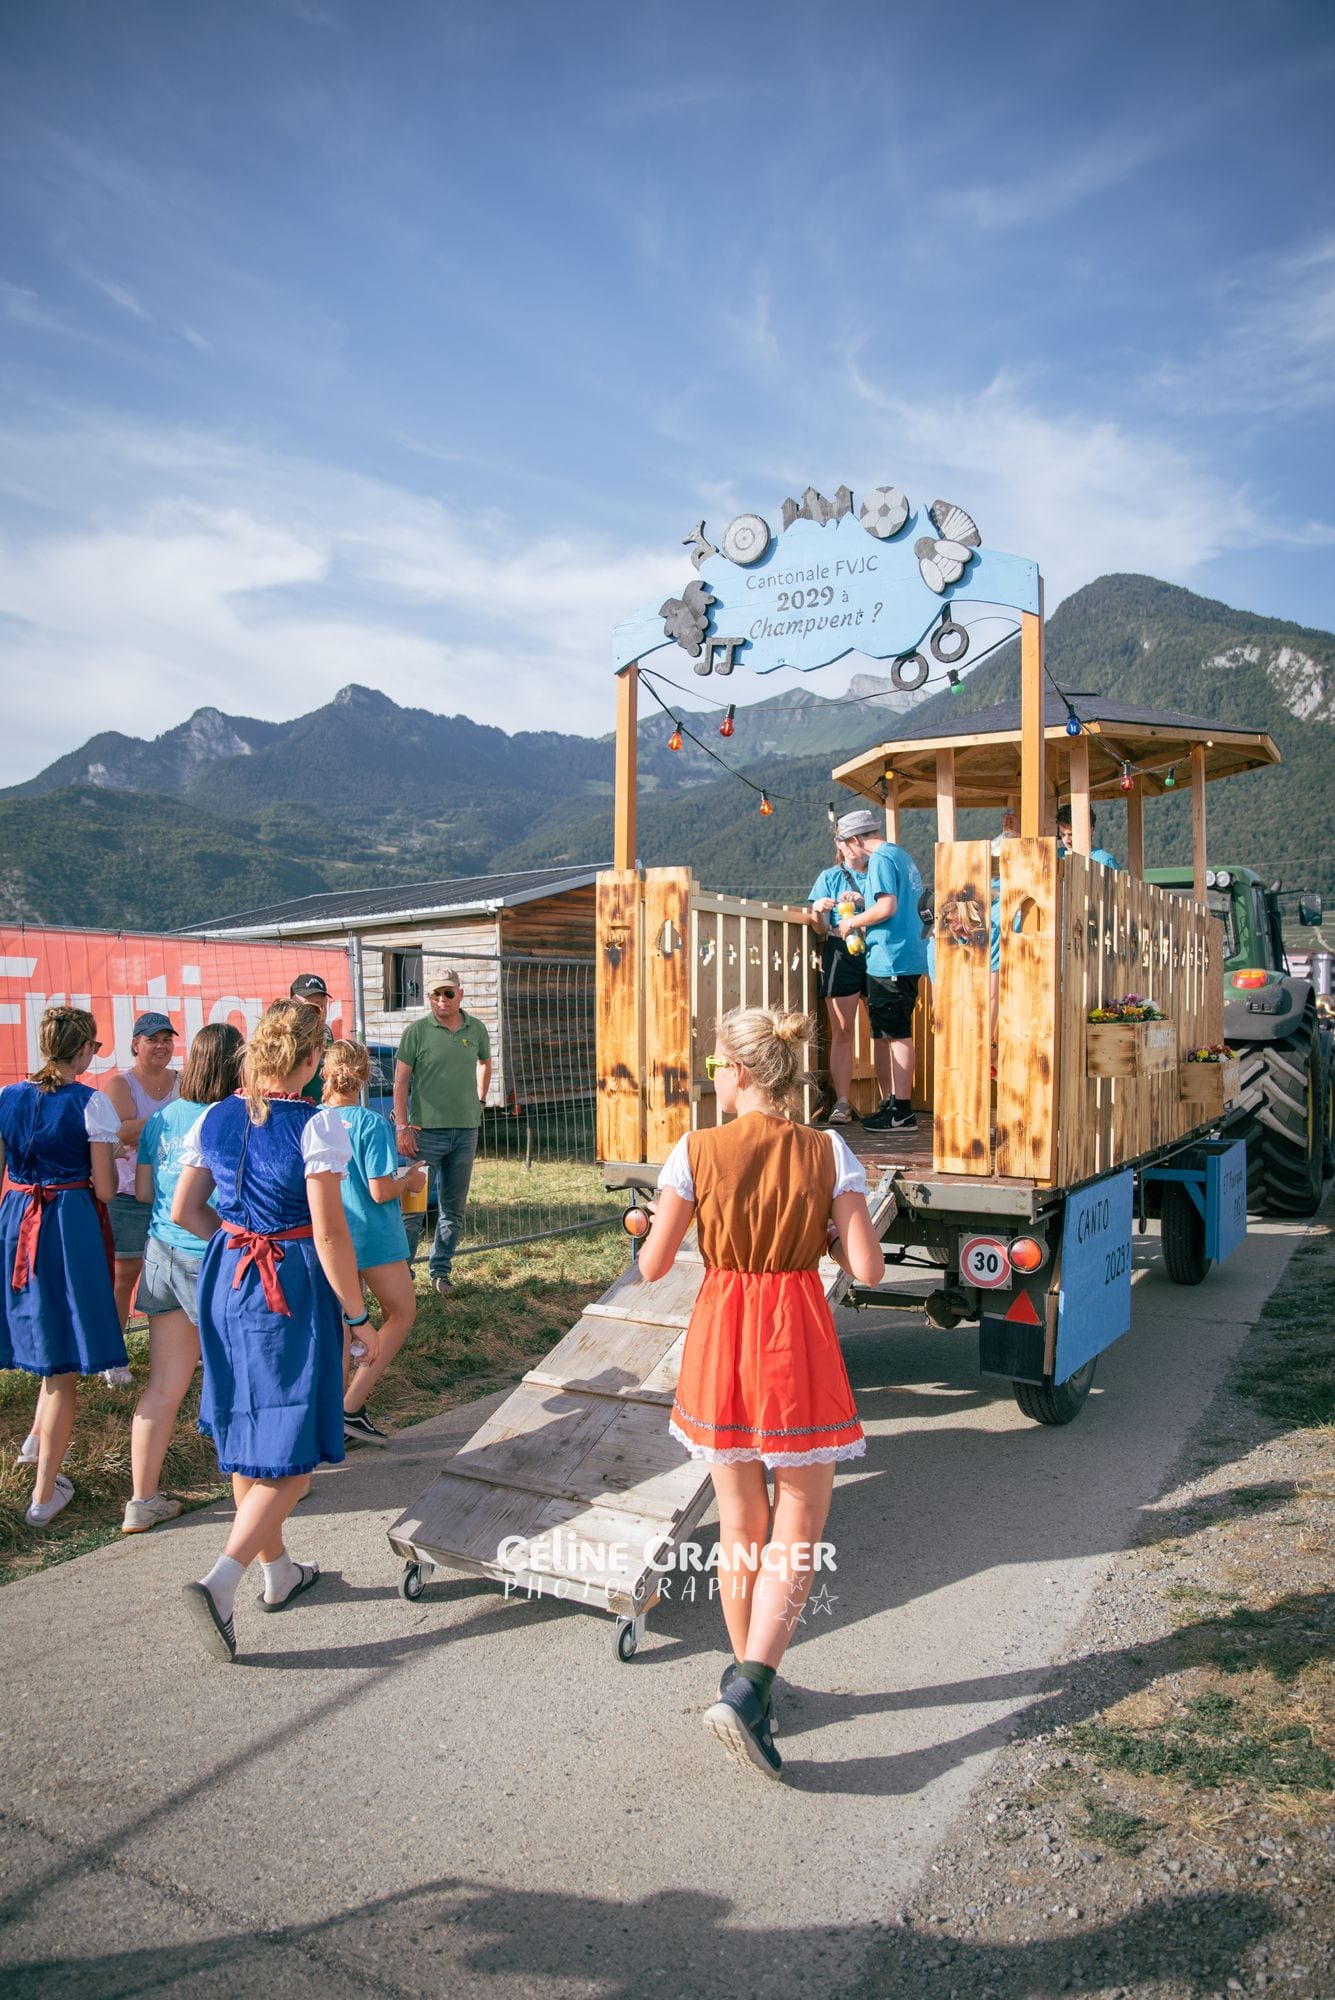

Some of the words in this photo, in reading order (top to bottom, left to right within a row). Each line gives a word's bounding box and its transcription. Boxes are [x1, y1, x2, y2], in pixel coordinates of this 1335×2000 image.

[745, 564, 830, 590] Cantonale
[835, 555, 879, 577] FVJC
[776, 585, 835, 613] 2029
[841, 590, 850, 603] à
[749, 608, 865, 640] Champvent
[871, 602, 884, 624] ?
[1077, 1198, 1110, 1245] CANTO
[974, 1251, 999, 1274] 30
